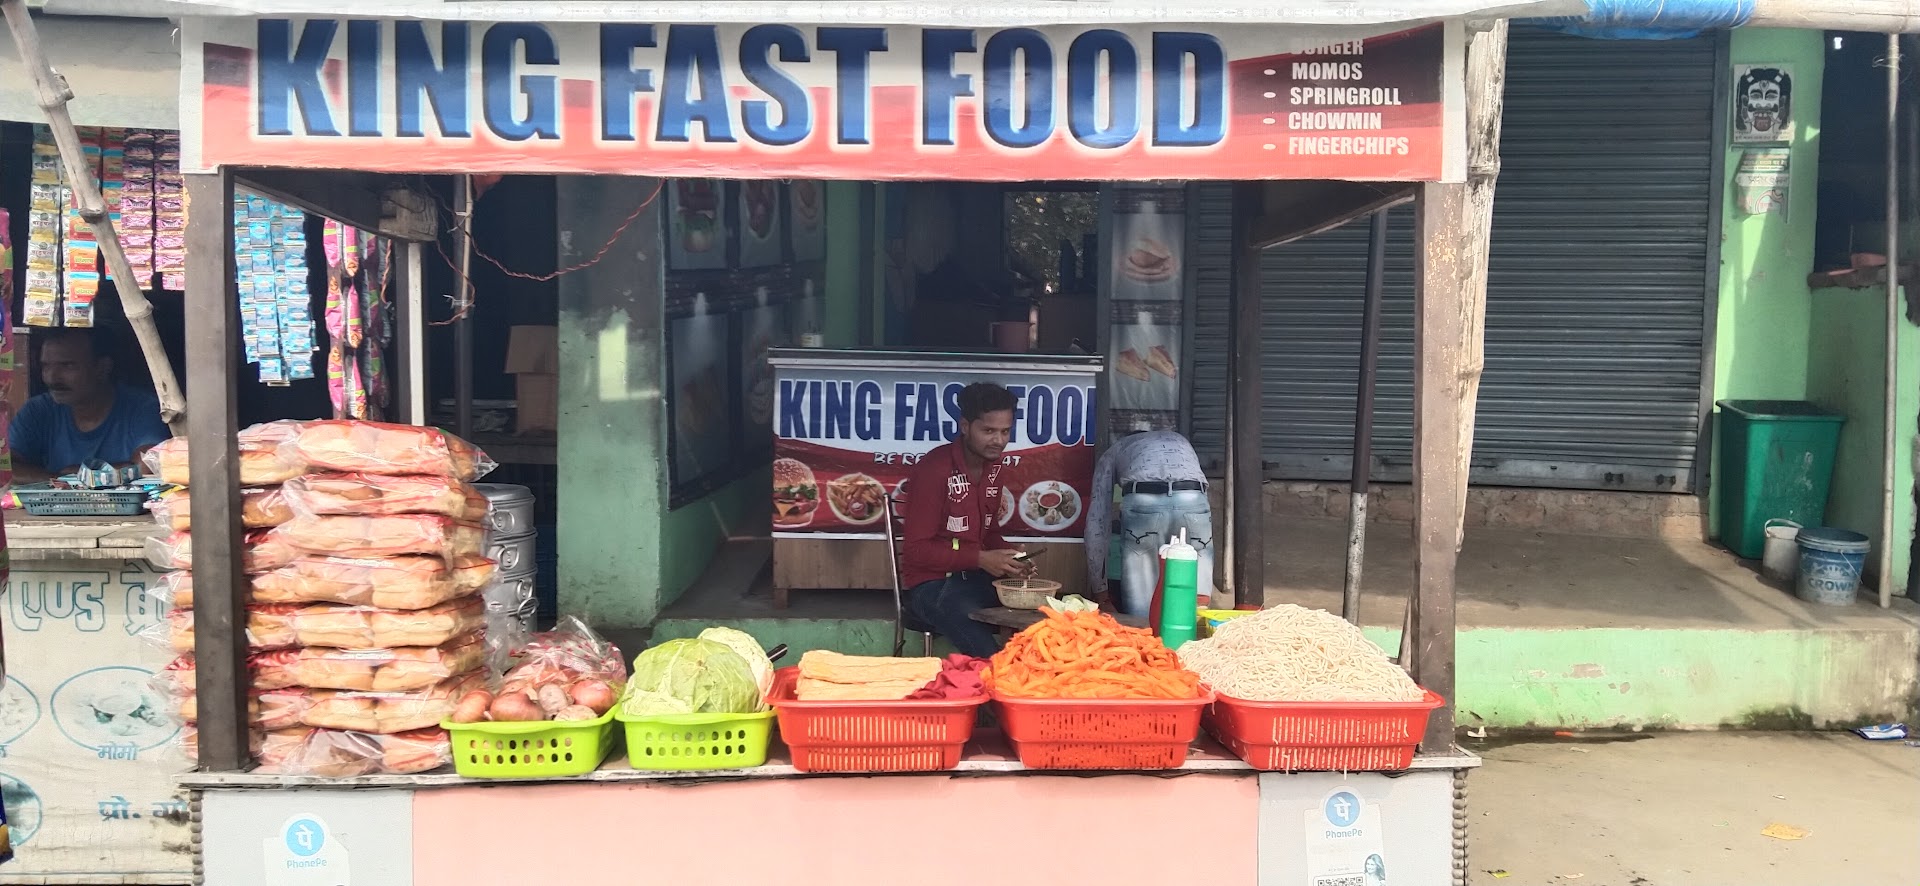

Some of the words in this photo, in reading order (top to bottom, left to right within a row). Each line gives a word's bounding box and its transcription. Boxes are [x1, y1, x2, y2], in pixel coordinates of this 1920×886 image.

[1292, 62, 1363, 80] MOMOS
[257, 19, 560, 141] KING
[600, 23, 888, 145] FAST
[920, 29, 1226, 148] FOOD
[1290, 87, 1402, 106] SPRINGROLL
[1288, 112, 1382, 130] CHOWMIN
[1288, 136, 1409, 155] FINGERCHIPS
[779, 379, 882, 441] KING
[894, 382, 961, 443] FAS
[1006, 385, 1096, 446] FOO
[874, 452, 898, 465] BE
[1002, 455, 1022, 467] AT
[1808, 577, 1856, 592] CROWN
[1325, 828, 1363, 839] PhonePe
[286, 857, 328, 869] PhonePe
